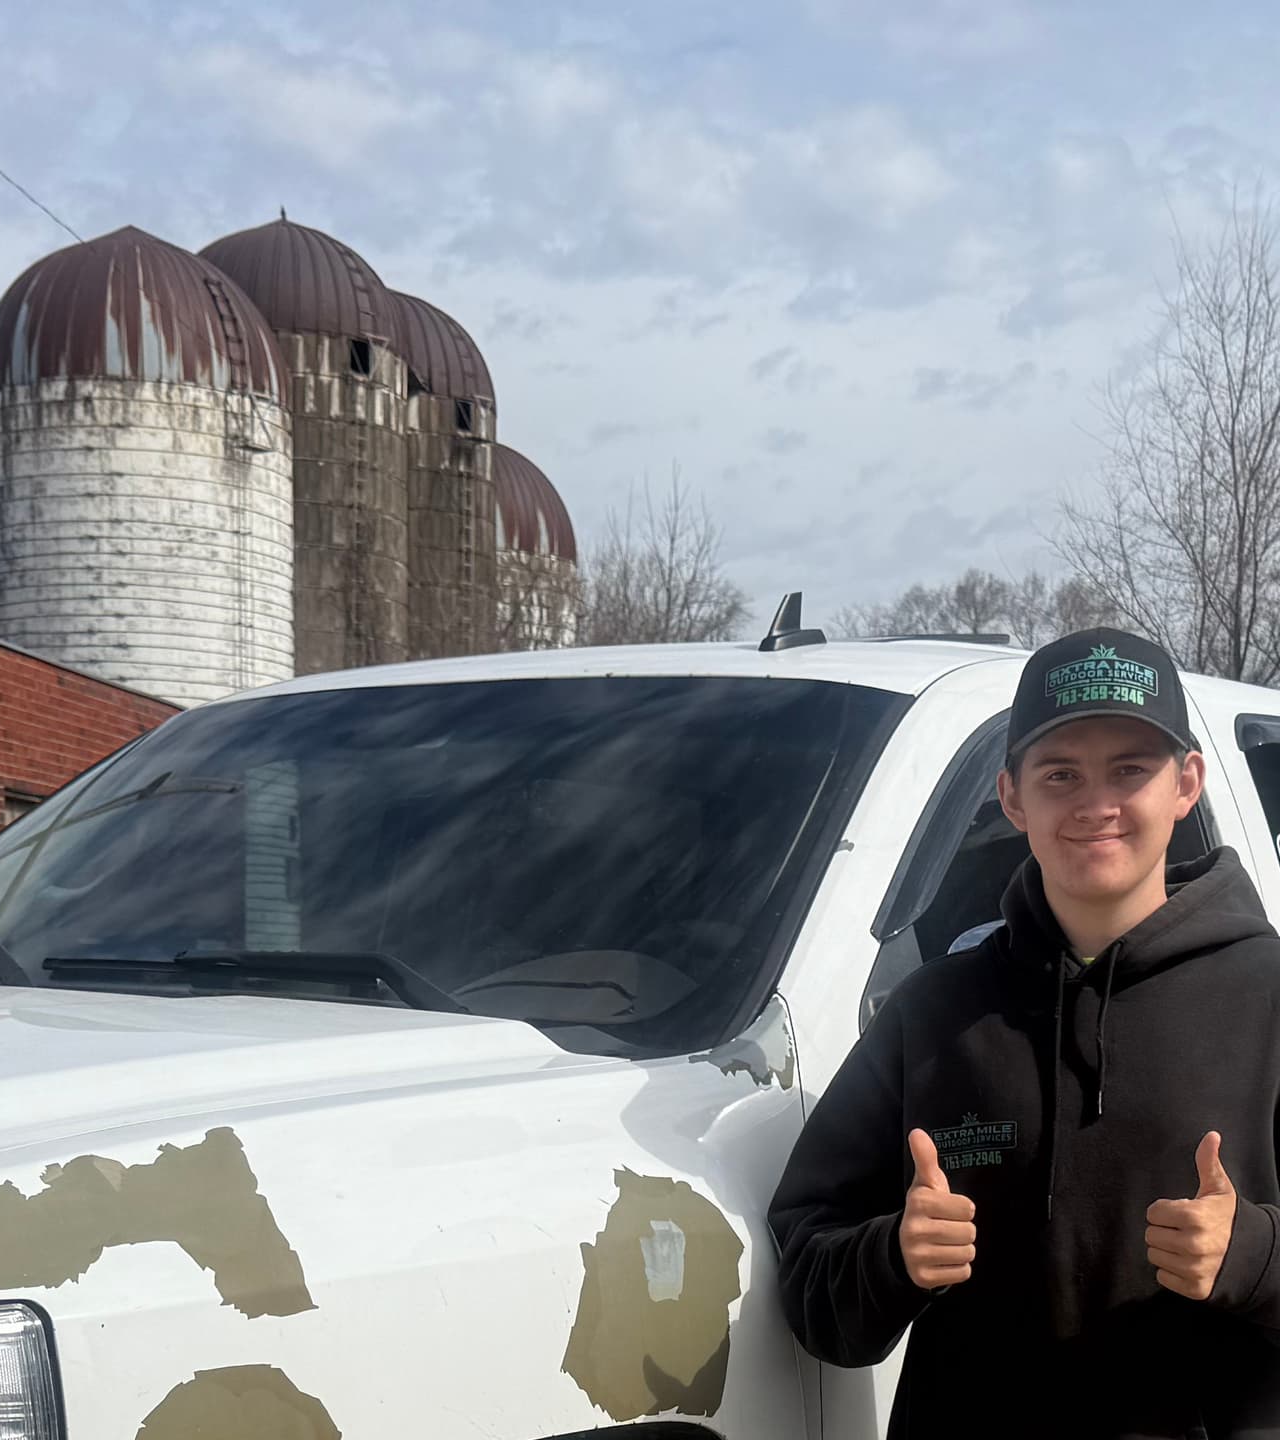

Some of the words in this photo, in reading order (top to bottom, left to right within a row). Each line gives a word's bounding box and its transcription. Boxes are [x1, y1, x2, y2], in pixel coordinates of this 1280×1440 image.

[1048, 670, 1104, 687] OUTDOOR
[1107, 670, 1154, 687] SERVICES
[1049, 660, 1111, 680] EXTRA
[1114, 661, 1154, 680] MILE
[1055, 685, 1145, 708] 763-269-2946
[934, 1128, 975, 1141] EXTRA
[976, 1124, 1013, 1135] MILE
